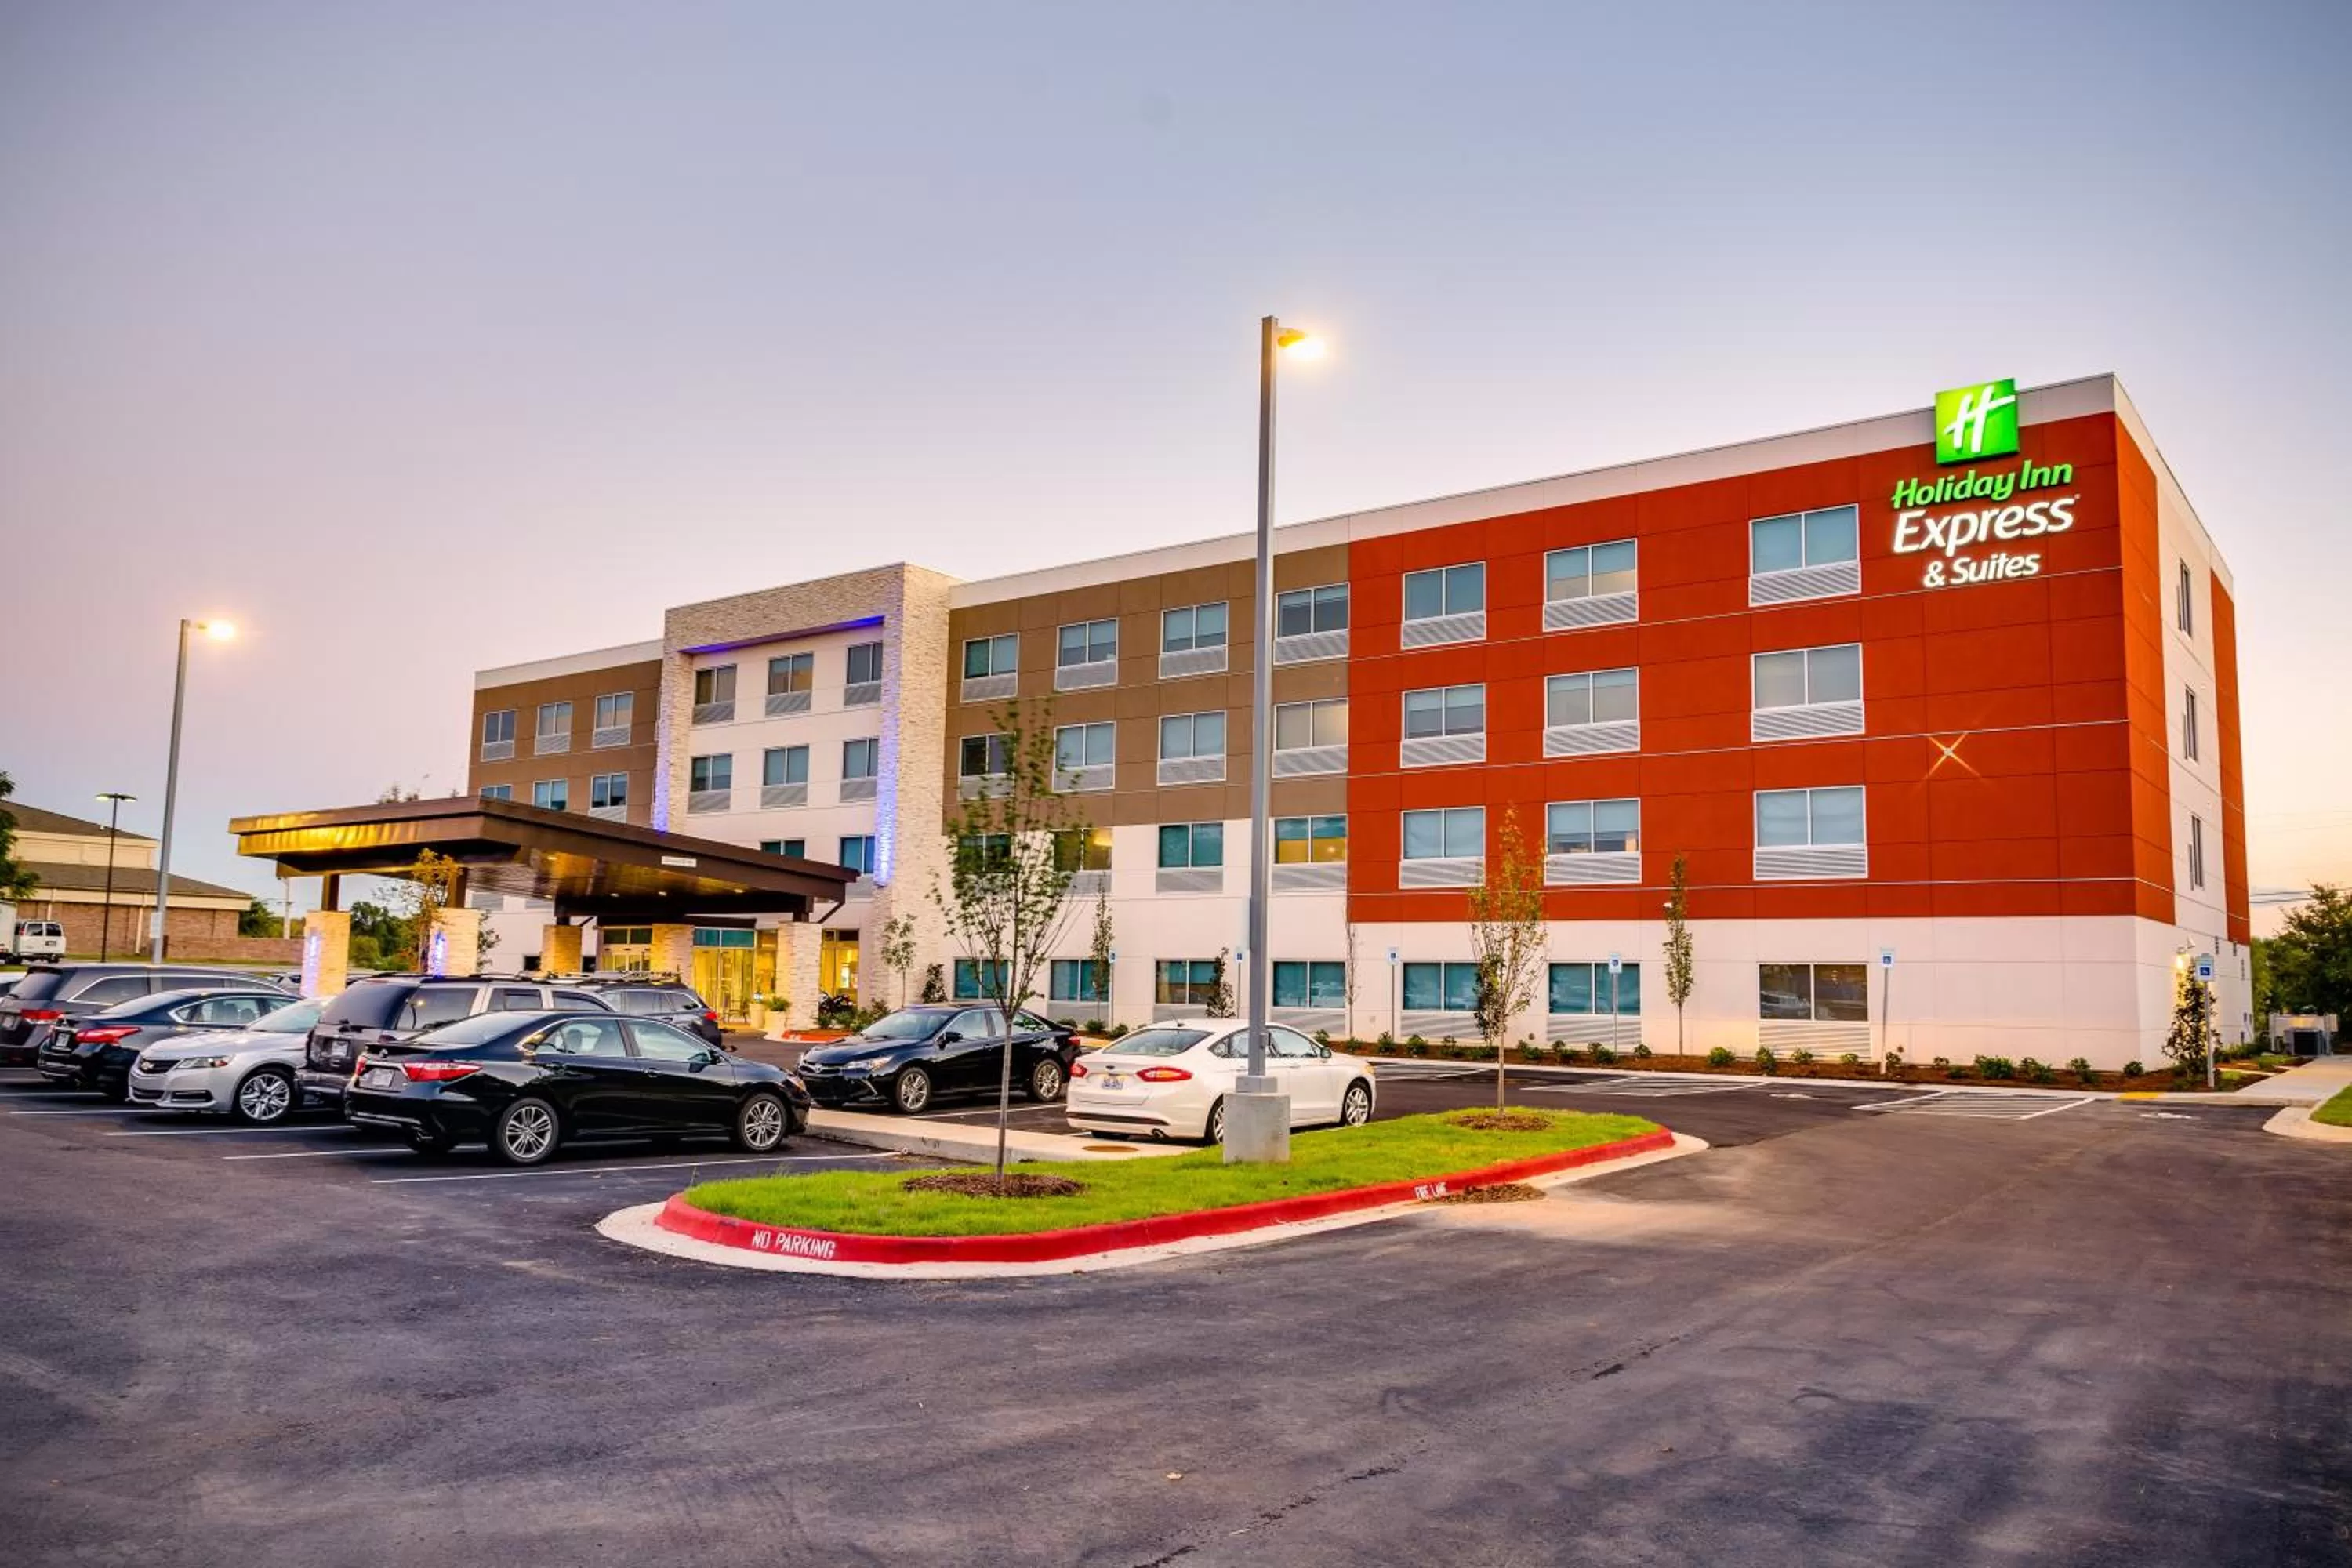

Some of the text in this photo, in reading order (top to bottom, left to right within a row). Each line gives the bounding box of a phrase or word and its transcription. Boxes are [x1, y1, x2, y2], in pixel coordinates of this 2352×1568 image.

[1891, 459, 2073, 509] Holiday Inn
[1893, 498, 2075, 557] Express
[1923, 553, 2041, 587] & Suites
[752, 1229, 836, 1260] NO PARKING
